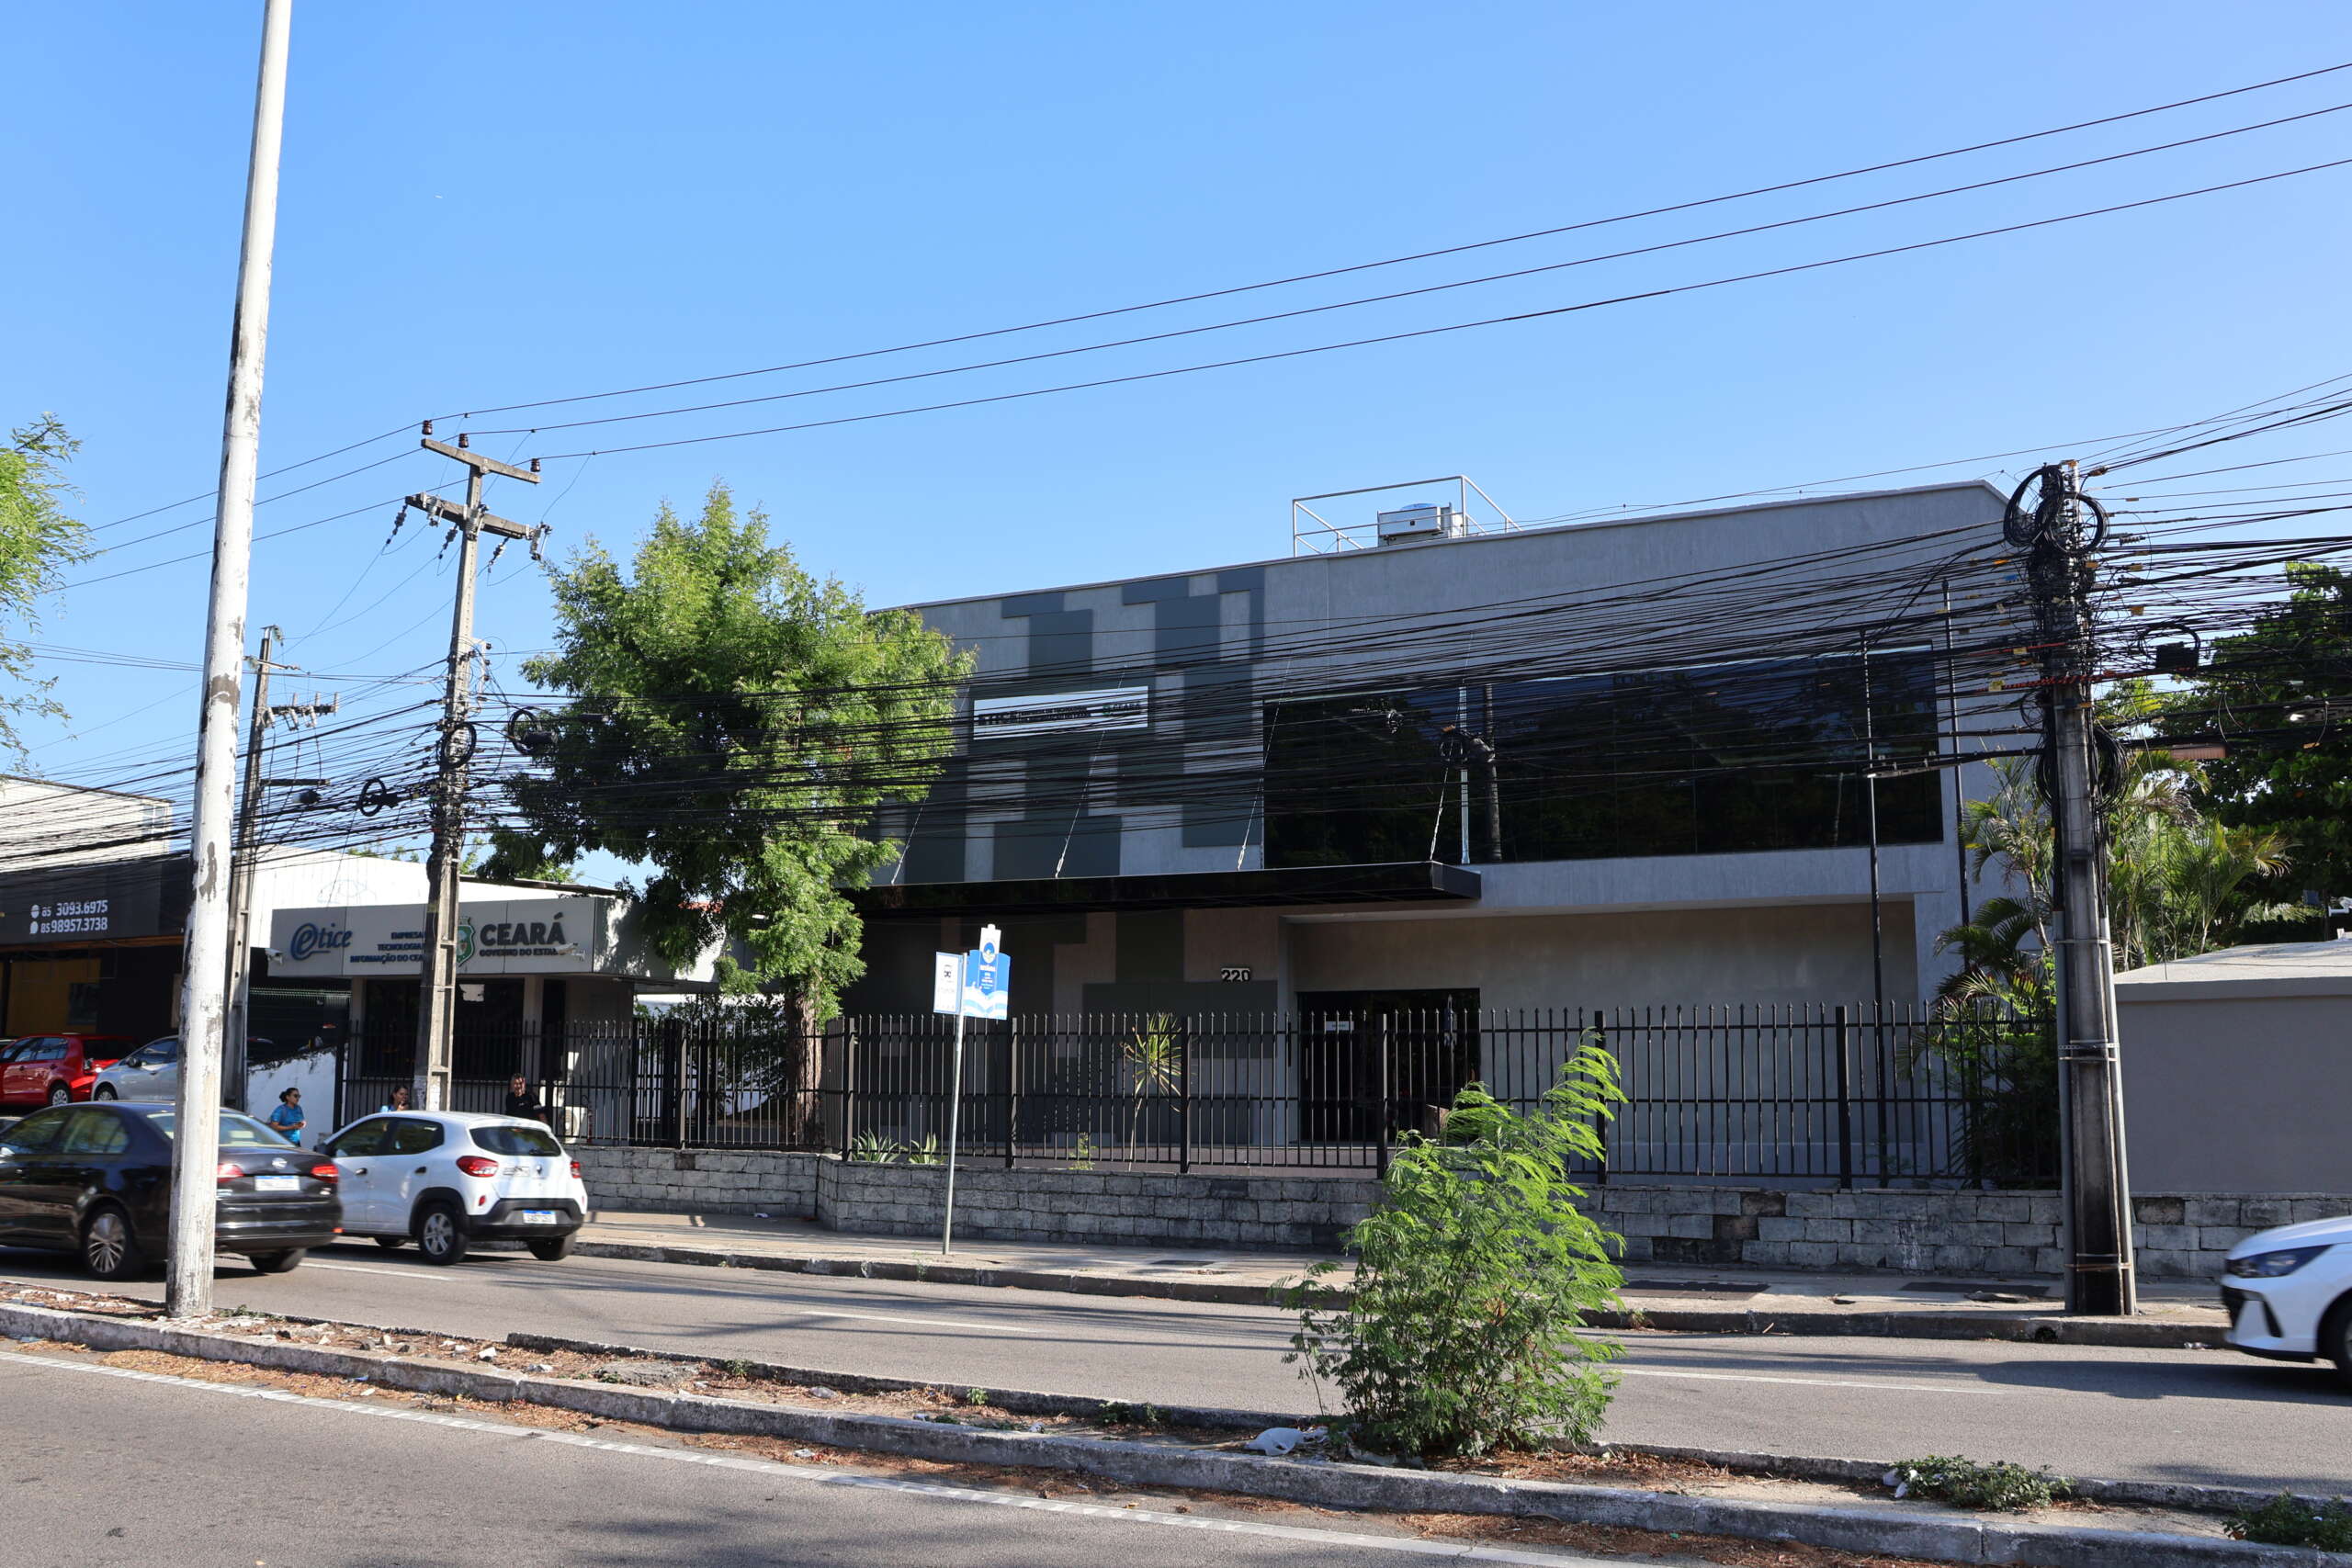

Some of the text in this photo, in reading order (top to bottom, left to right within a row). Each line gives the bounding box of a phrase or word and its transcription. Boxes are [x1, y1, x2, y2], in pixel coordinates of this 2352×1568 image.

[41, 899, 108, 917] 85 3093.6975
[40, 917, 108, 933] 85 98957.3738
[480, 912, 566, 946] CEARÁ
[397, 954, 408, 963] DO
[479, 948, 517, 956] GOVERNO
[519, 948, 532, 956] DO
[1221, 968, 1251, 983] 220
